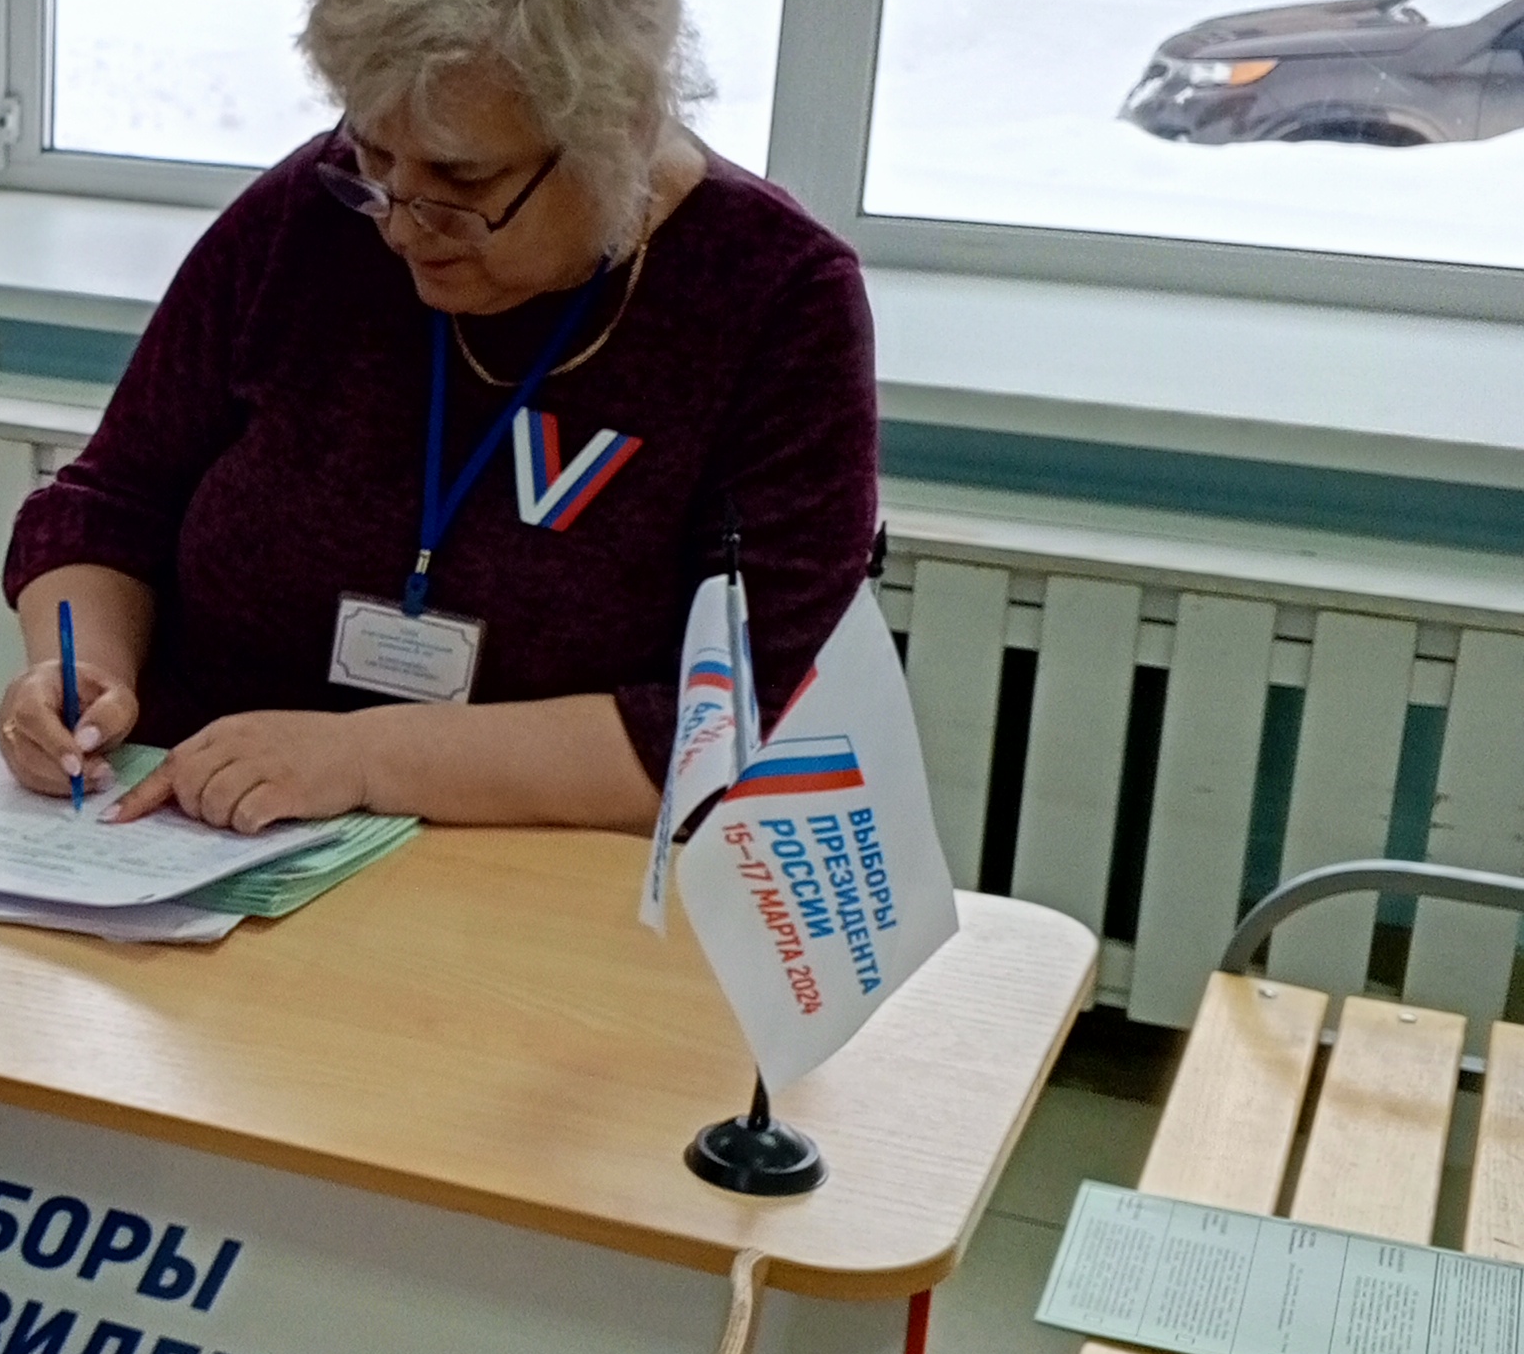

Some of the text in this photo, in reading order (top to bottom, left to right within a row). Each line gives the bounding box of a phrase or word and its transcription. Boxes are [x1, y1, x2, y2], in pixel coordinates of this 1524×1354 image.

[758, 818, 836, 939] РОССИИ
[806, 814, 883, 995] ПРЕЗИДЕНТА
[847, 807, 897, 931] ВЫБОРЫ
[751, 888, 805, 963] МАРТА
[787, 965, 823, 1016] 2024
